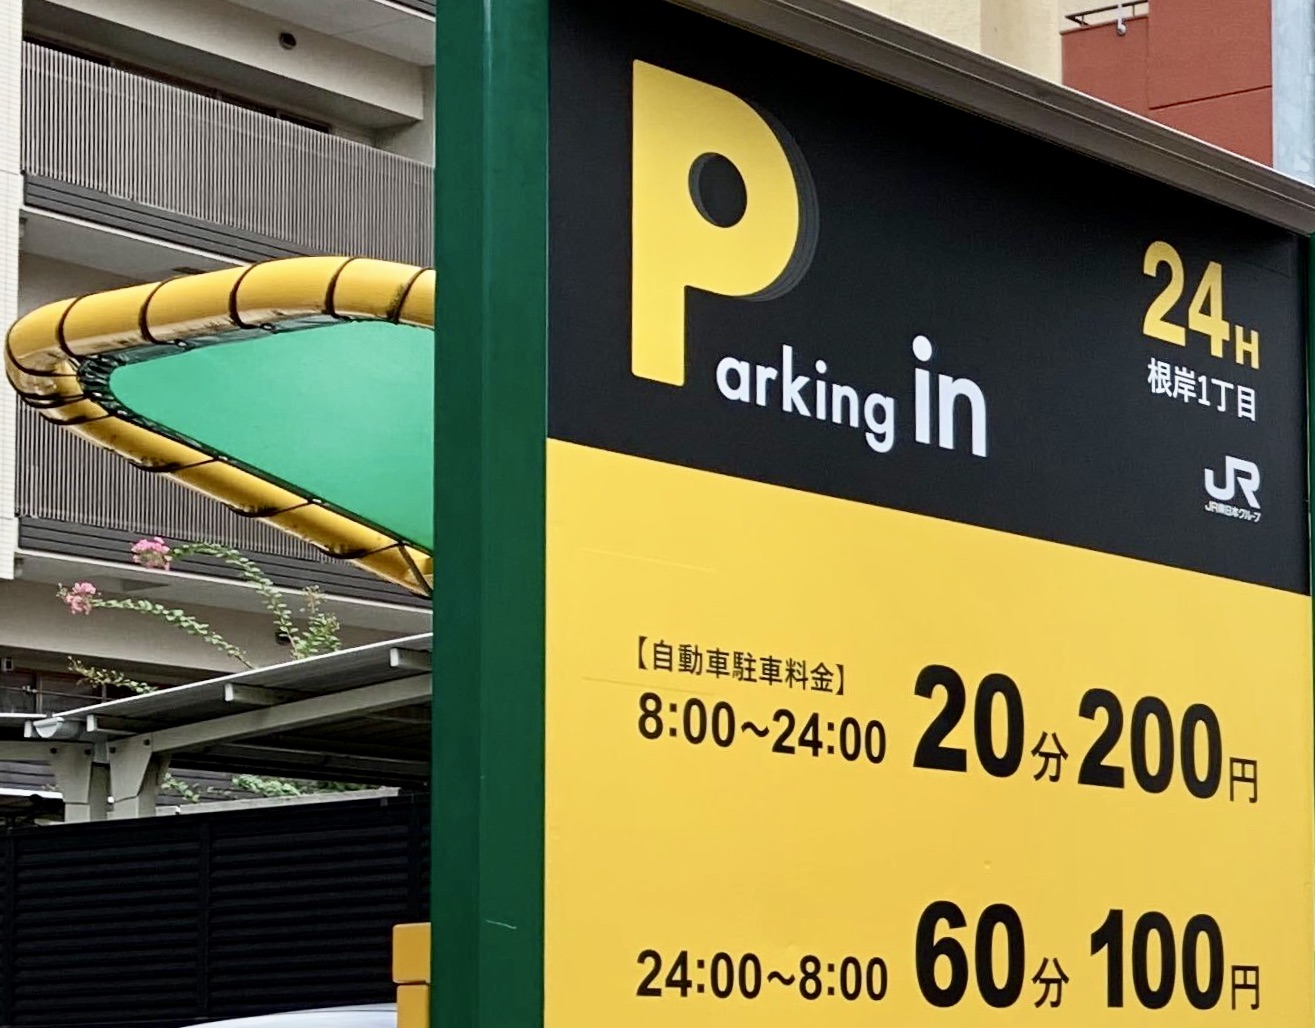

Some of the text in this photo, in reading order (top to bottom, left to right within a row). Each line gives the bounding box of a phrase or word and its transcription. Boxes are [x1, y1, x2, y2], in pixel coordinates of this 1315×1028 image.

[914, 335, 987, 457] in
[1147, 357, 1256, 422] 根岸1丁目
[1204, 455, 1261, 509] JR
